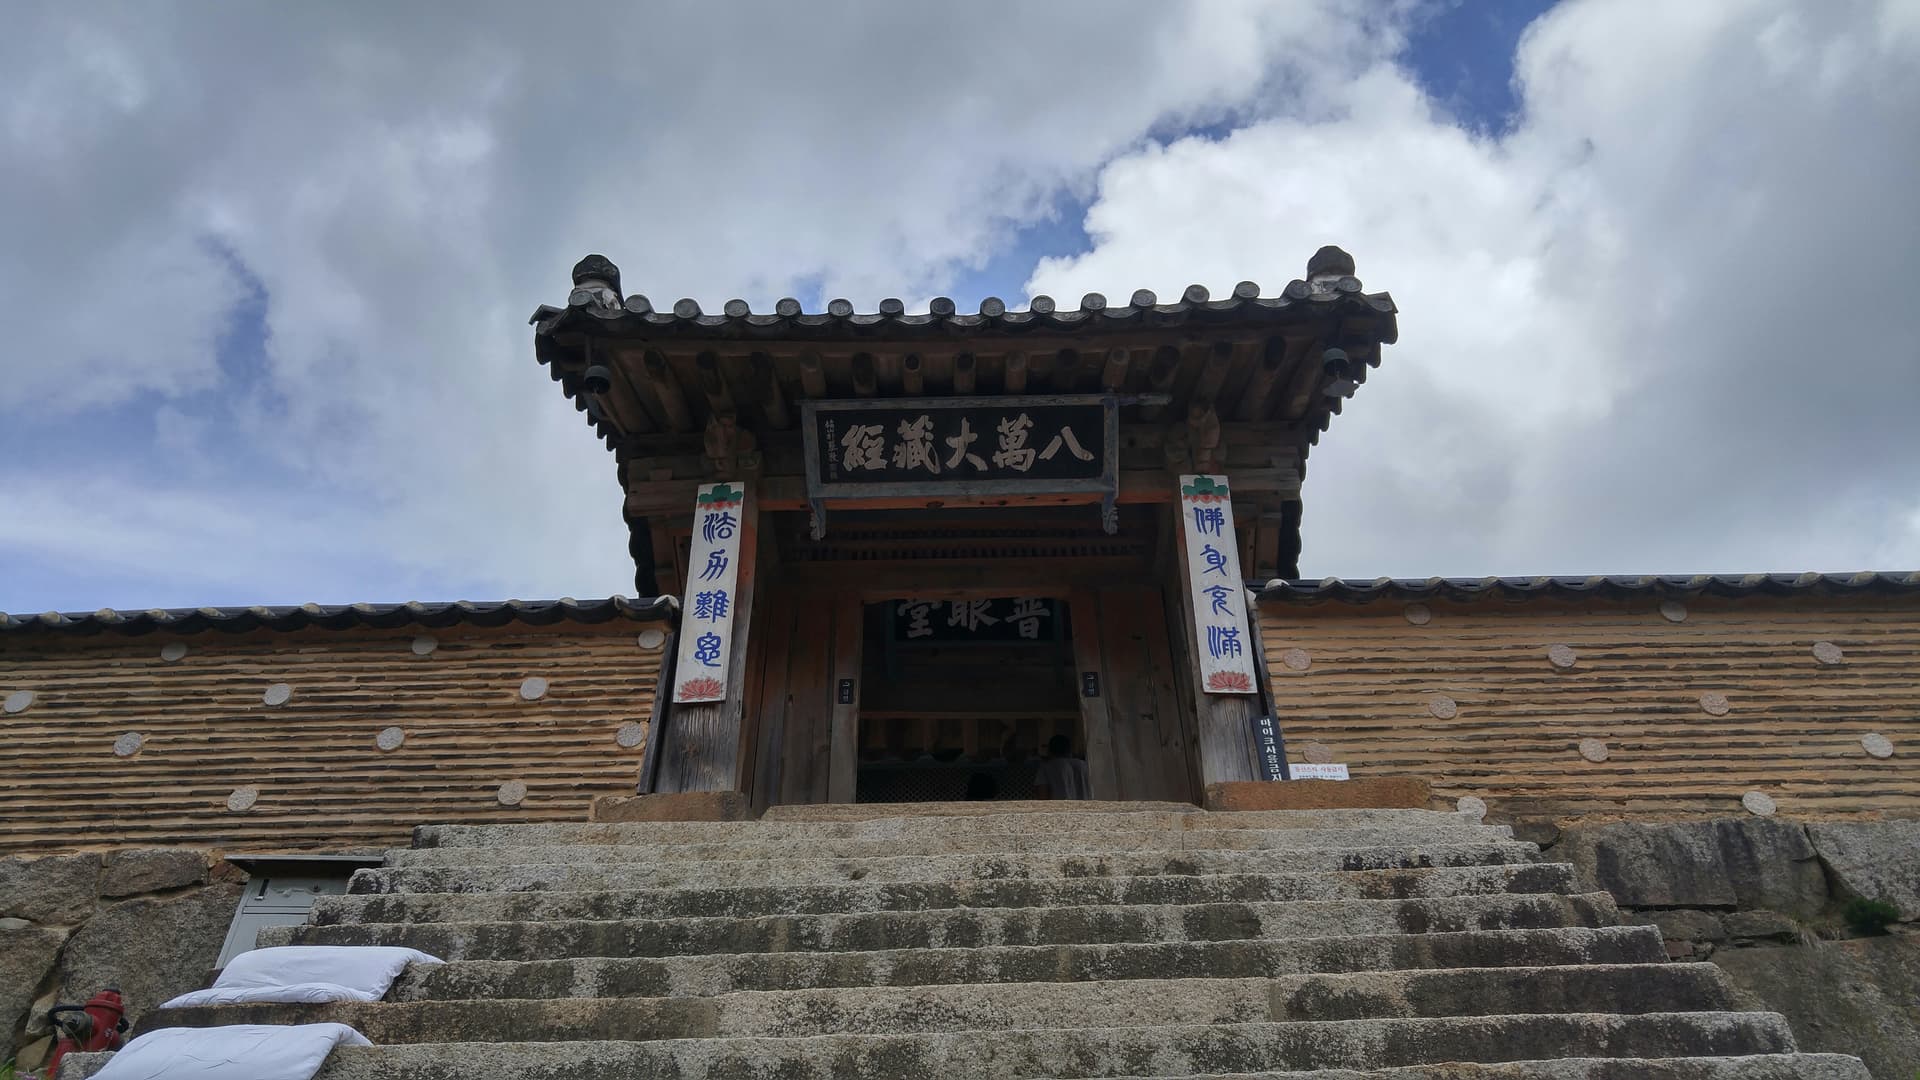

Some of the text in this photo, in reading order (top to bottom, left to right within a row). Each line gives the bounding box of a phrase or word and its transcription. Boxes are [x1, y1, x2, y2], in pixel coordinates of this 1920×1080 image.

[840, 412, 1095, 475] 八萬大藏經
